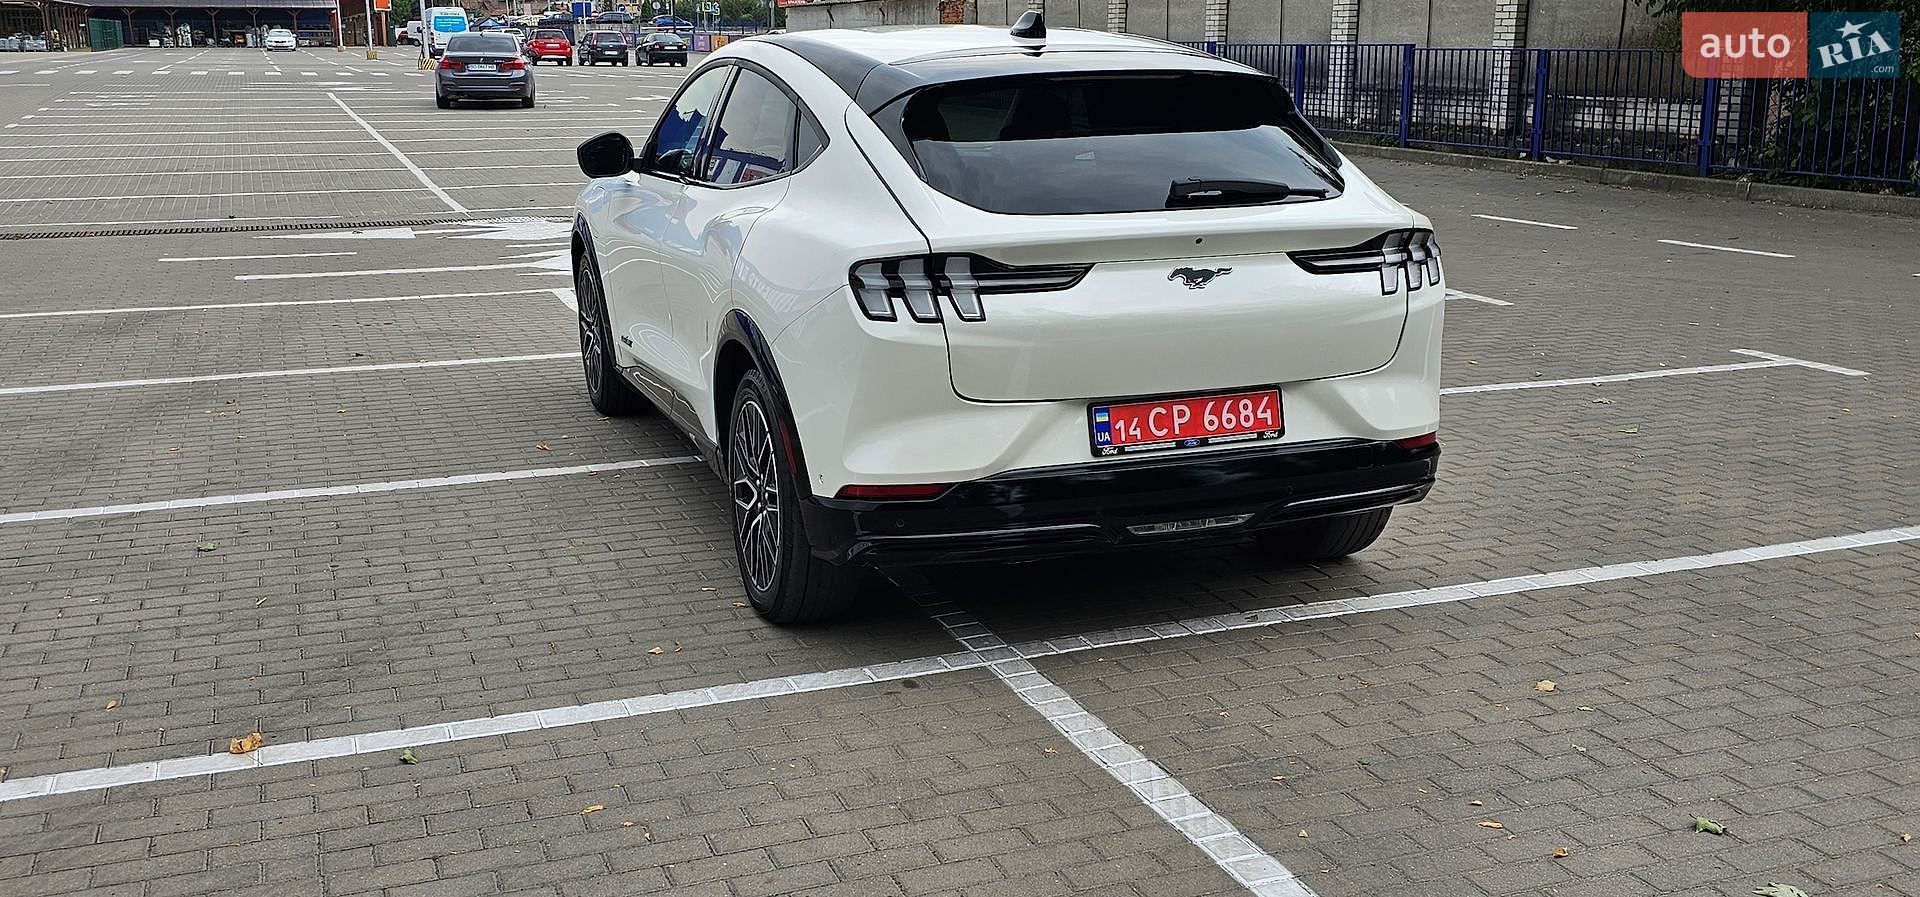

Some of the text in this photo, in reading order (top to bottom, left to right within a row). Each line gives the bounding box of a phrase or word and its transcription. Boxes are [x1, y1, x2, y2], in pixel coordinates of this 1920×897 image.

[1114, 396, 1273, 442] 14 CP 6684
[1097, 432, 1111, 442] UA
[1102, 447, 1118, 456] Ford
[1263, 431, 1278, 439] Ford
